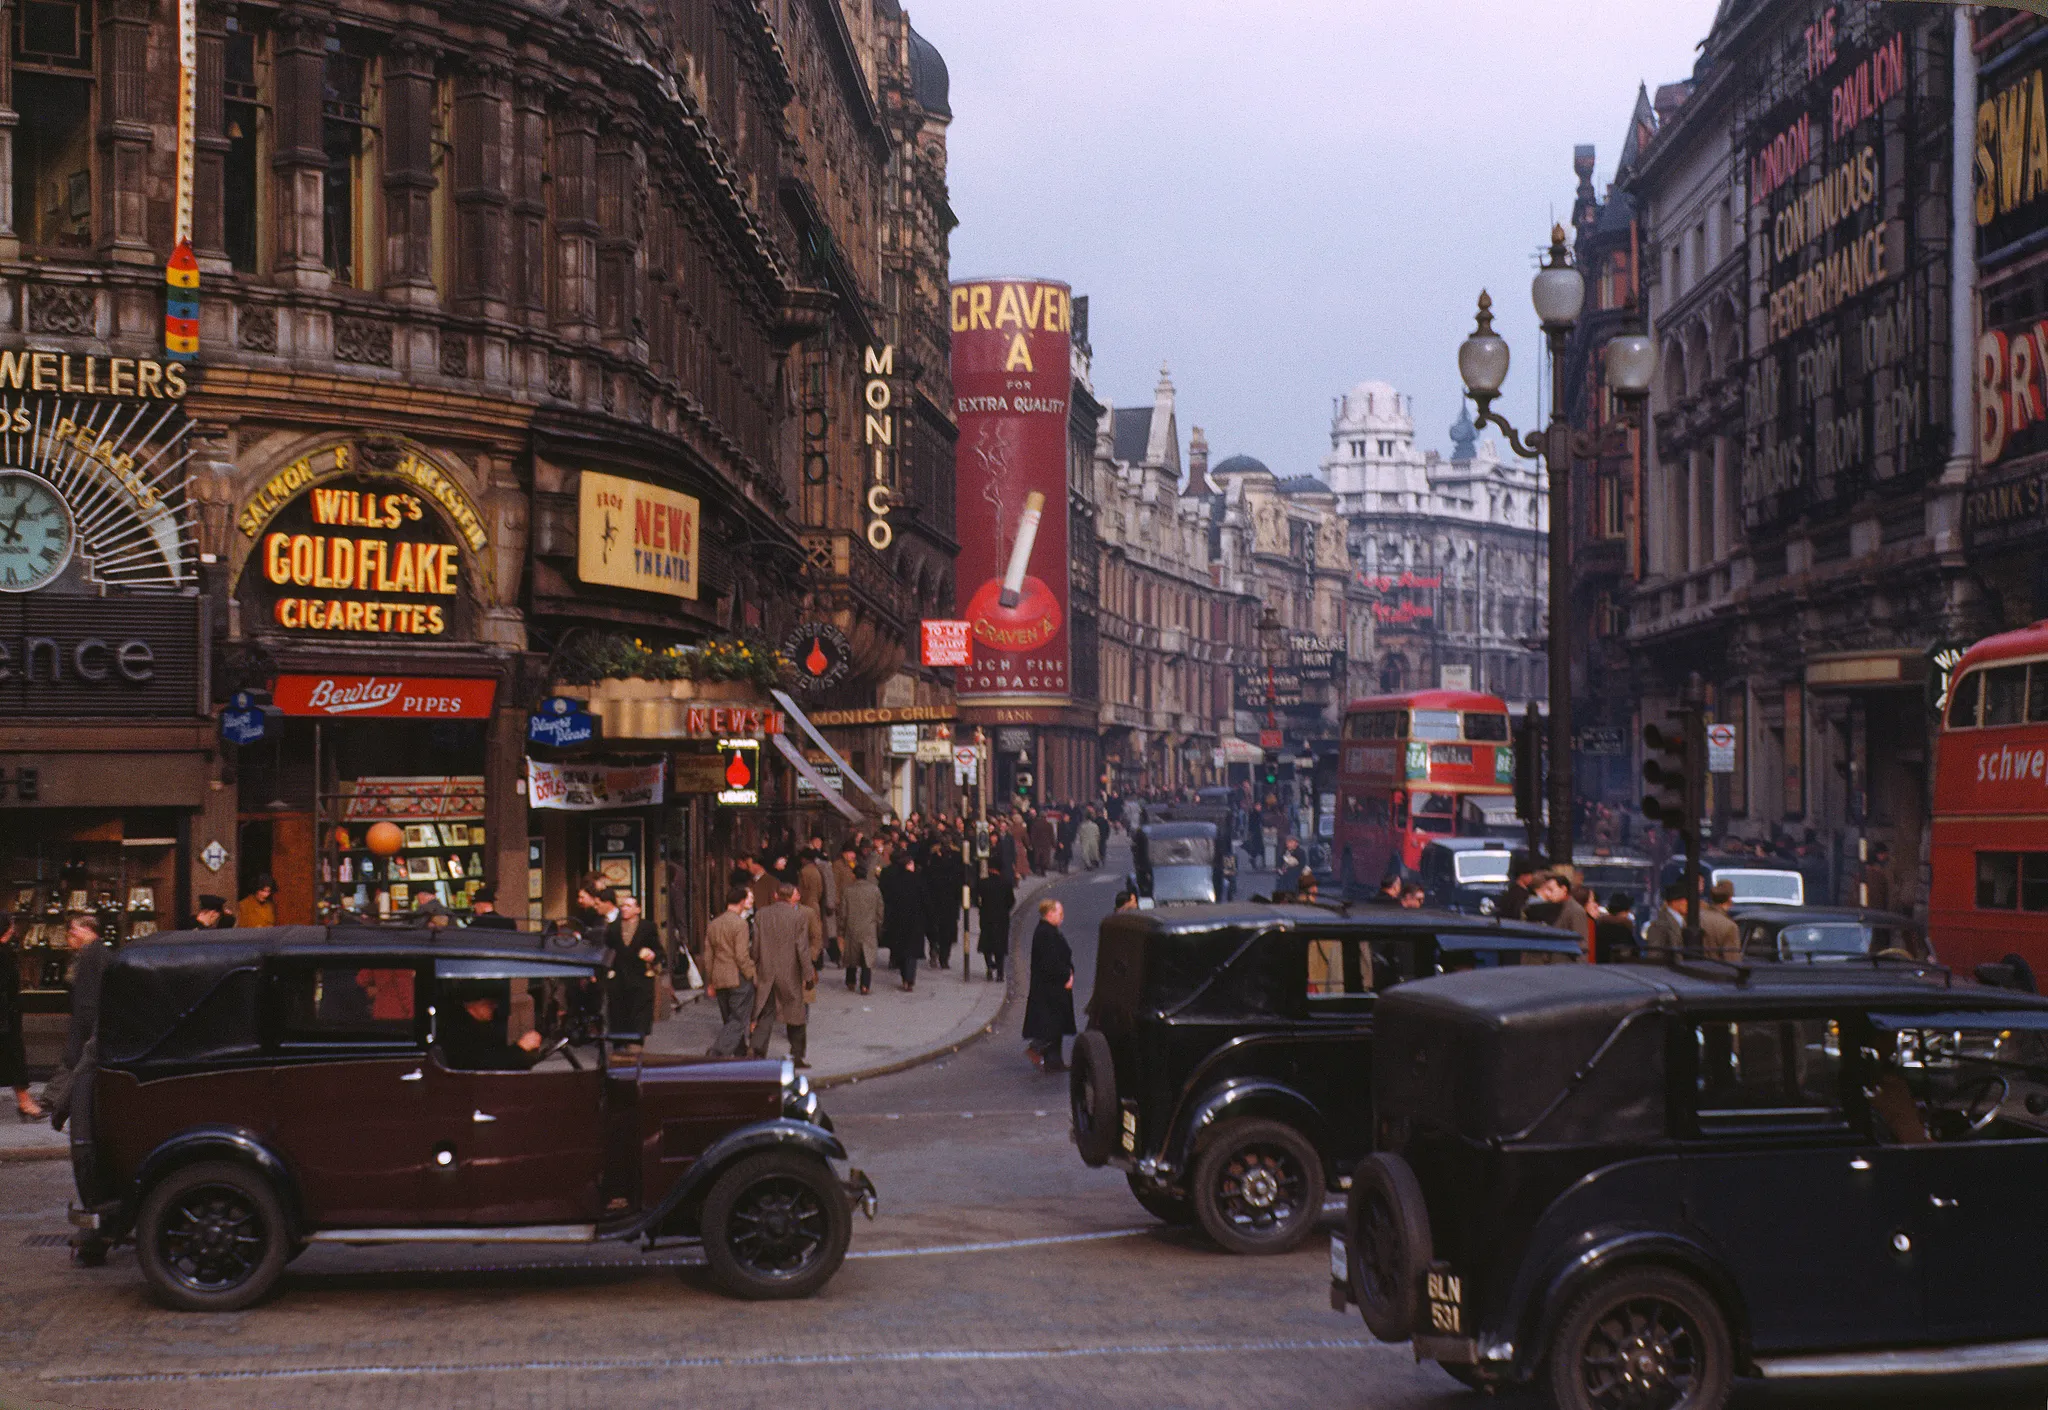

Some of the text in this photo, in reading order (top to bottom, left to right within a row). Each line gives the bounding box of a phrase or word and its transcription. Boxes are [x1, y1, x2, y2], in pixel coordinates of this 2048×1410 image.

[1804, 7, 1837, 81] THE
[1751, 31, 1903, 206] LONDON PAVILION
[1977, 69, 2048, 226] SWA
[1775, 145, 1874, 263] CONTINUOUS
[1768, 220, 1887, 345] PERFORMANCE
[951, 284, 1071, 332] CRAVEN
[0, 350, 187, 399] WELLERS
[1006, 380, 1032, 390] FOR
[1797, 335, 1841, 408] FROM
[958, 396, 1065, 414] EXTRA QUALITY
[865, 344, 893, 550] MONICO
[239, 456, 316, 536] SALMON
[596, 492, 623, 511] EROS
[635, 498, 692, 556] NEWS
[634, 549, 690, 583] THEATRE
[275, 598, 445, 635] CIGARETTES
[974, 618, 1038, 644] CRAVEN
[1289, 636, 1346, 651] TREASURE
[1303, 652, 1334, 667] HUNT
[964, 676, 1064, 688] TOBACCO
[1026, 659, 1064, 672] FINE
[308, 677, 462, 713] Bewlay PIPES
[1247, 695, 1301, 706] CLEENTS
[687, 707, 760, 733] NEWS
[812, 708, 892, 724] MONICO
[901, 705, 953, 720] GRILL
[997, 709, 1033, 721] BANK
[1977, 744, 2048, 787] schwe
